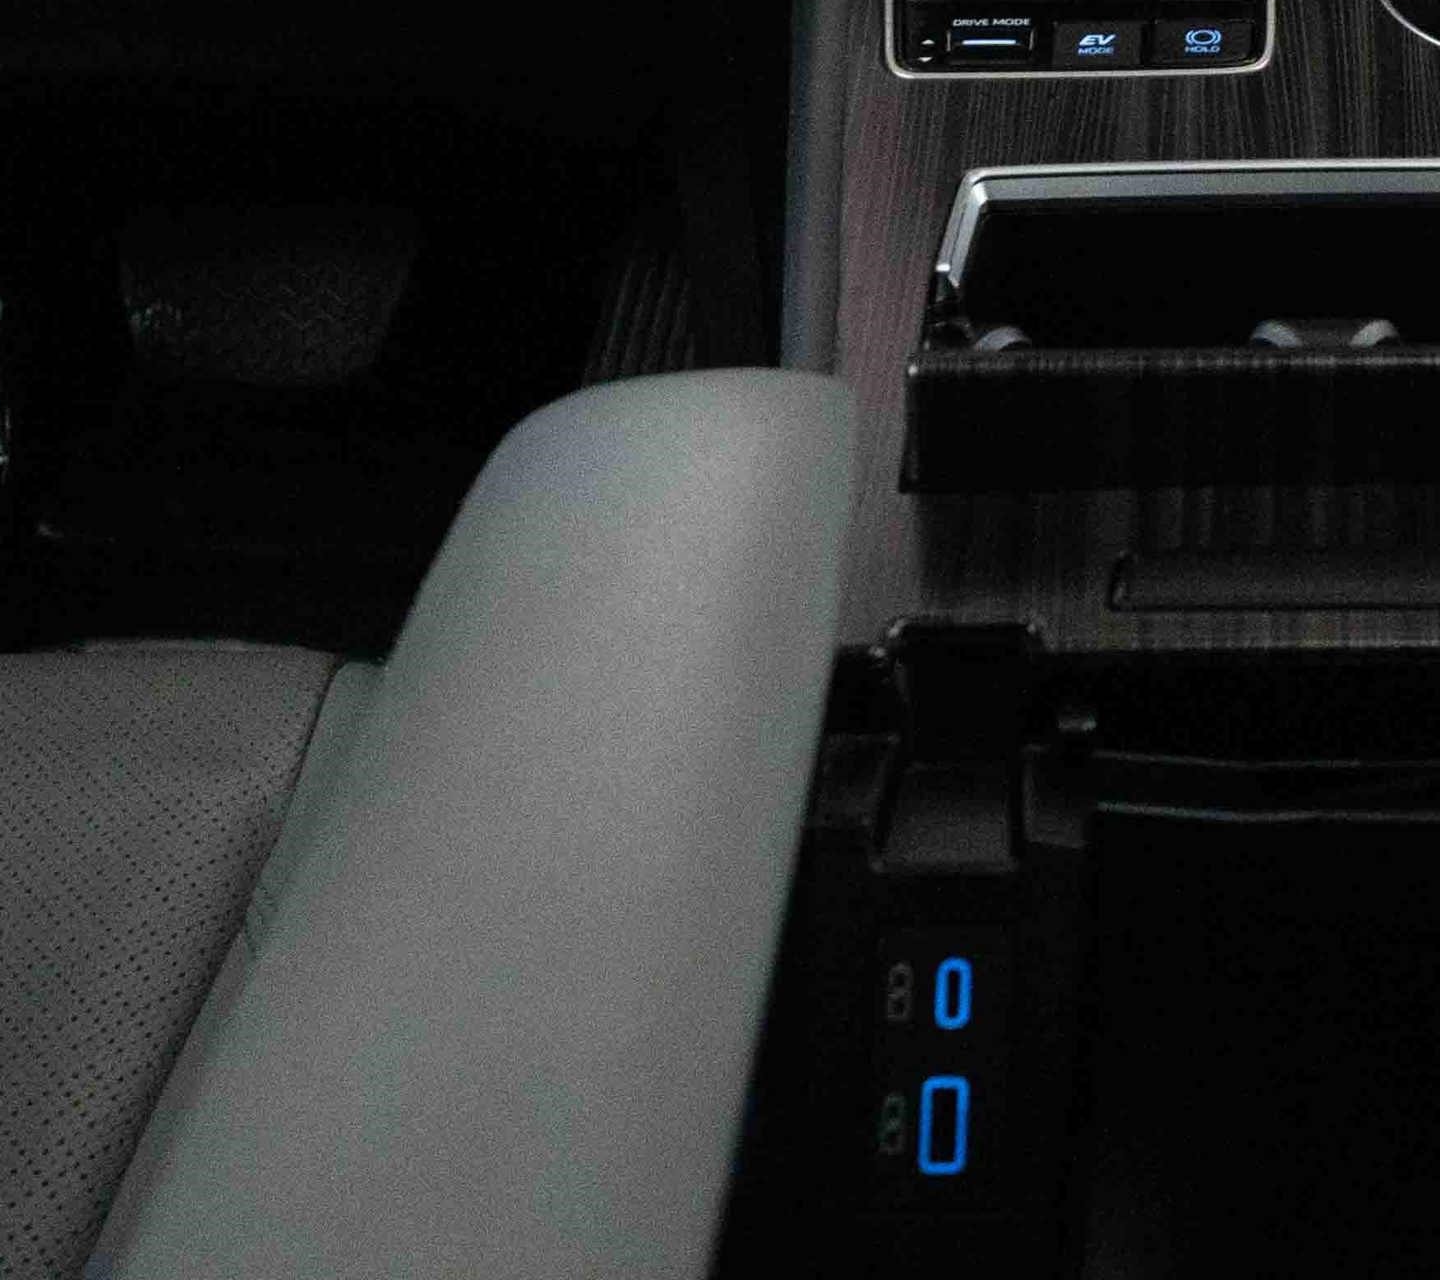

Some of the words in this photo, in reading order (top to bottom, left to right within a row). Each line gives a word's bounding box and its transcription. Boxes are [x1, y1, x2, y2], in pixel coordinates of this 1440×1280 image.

[952, 17, 989, 27] DRIVE
[992, 17, 1030, 26] MODE
[1079, 33, 1117, 46] EV
[1078, 46, 1115, 55] MODE
[1184, 45, 1221, 54] HOLD
